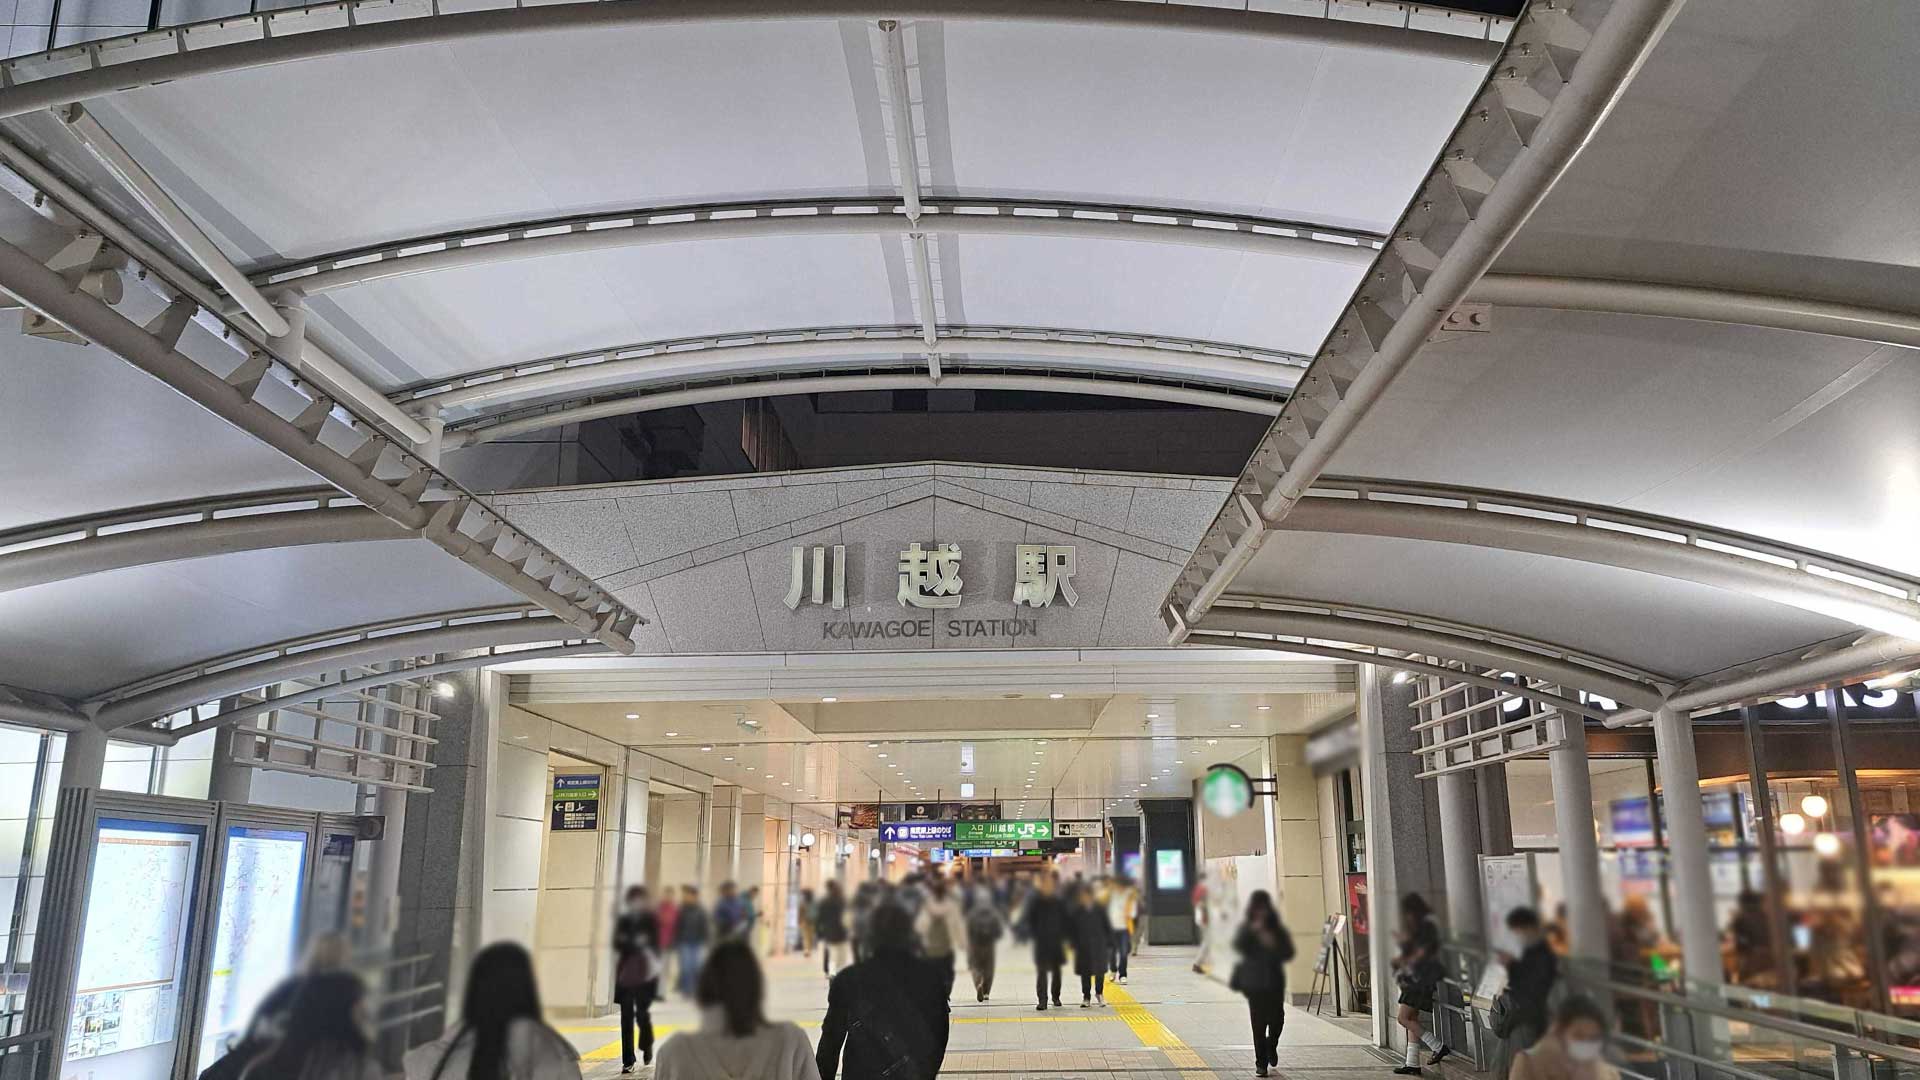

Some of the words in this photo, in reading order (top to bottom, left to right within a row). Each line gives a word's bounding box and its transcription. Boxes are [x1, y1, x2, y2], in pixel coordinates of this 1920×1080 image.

[784, 542, 1079, 609] 川越駅
[823, 620, 931, 639] KAWAGOE
[948, 619, 1037, 637] STATION
[989, 823, 1016, 833] 川越駅
[1017, 823, 1036, 835] JR
